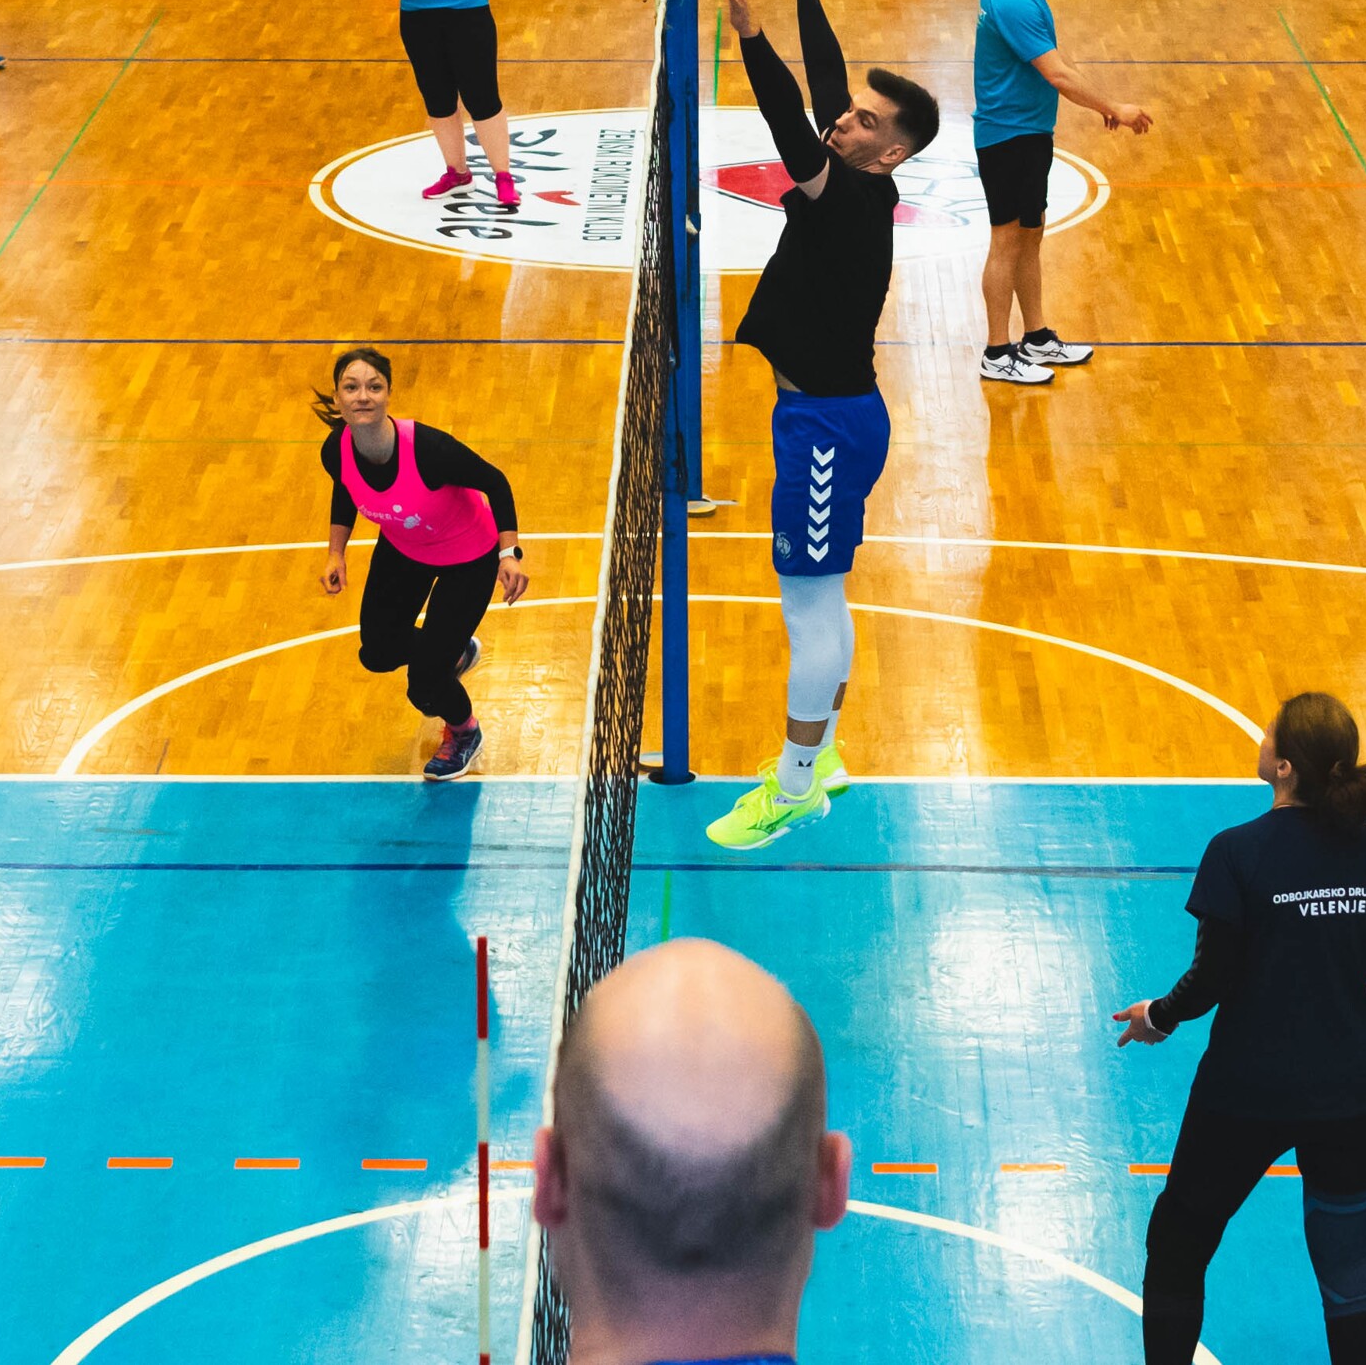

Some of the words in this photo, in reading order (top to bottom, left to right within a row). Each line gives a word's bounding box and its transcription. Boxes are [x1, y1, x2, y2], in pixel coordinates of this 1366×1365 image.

[586, 160, 633, 213] ROKOMETNI
[582, 216, 625, 241] KLUB
[1273, 887, 1346, 904] ODBOJKARSKO
[1299, 900, 1366, 916] VELENJE
